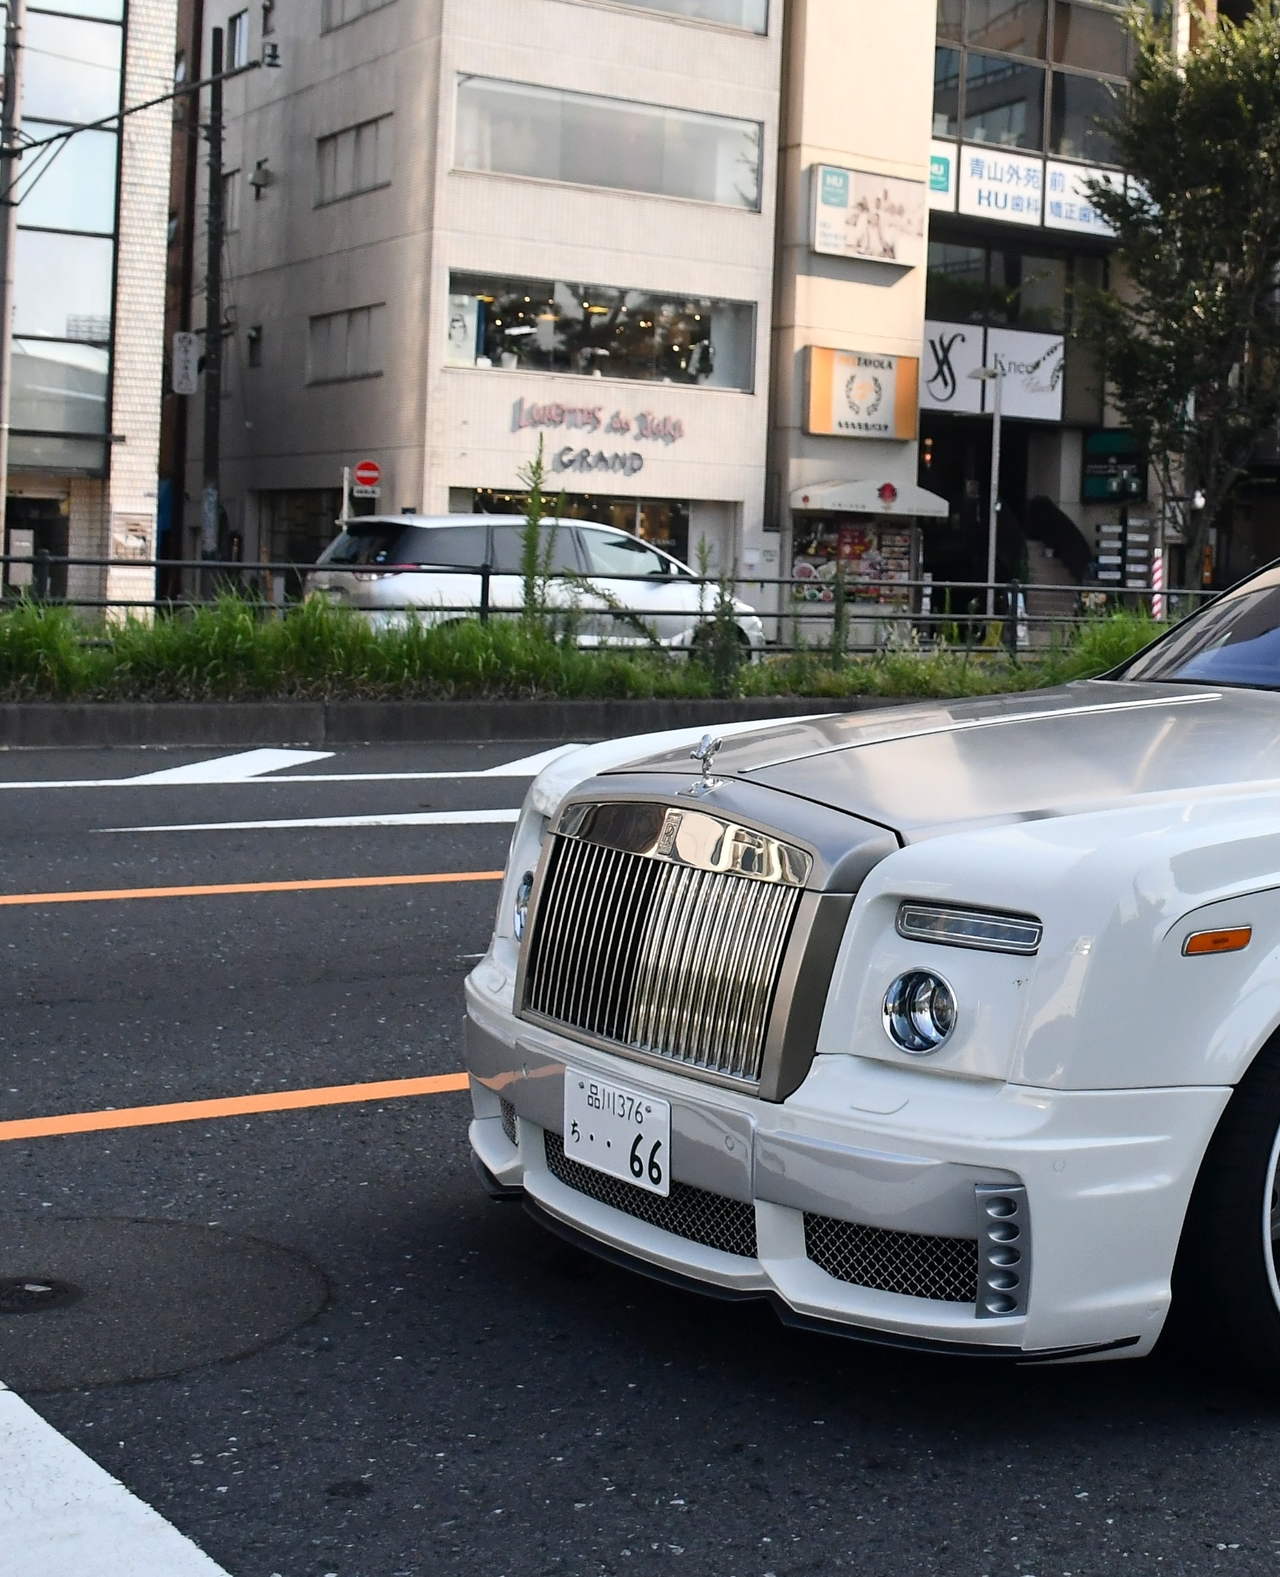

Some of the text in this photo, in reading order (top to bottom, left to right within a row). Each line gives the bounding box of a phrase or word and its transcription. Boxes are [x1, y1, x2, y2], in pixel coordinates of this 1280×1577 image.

[969, 157, 1066, 193] 青山外苑前
[555, 445, 643, 475] GRAND
